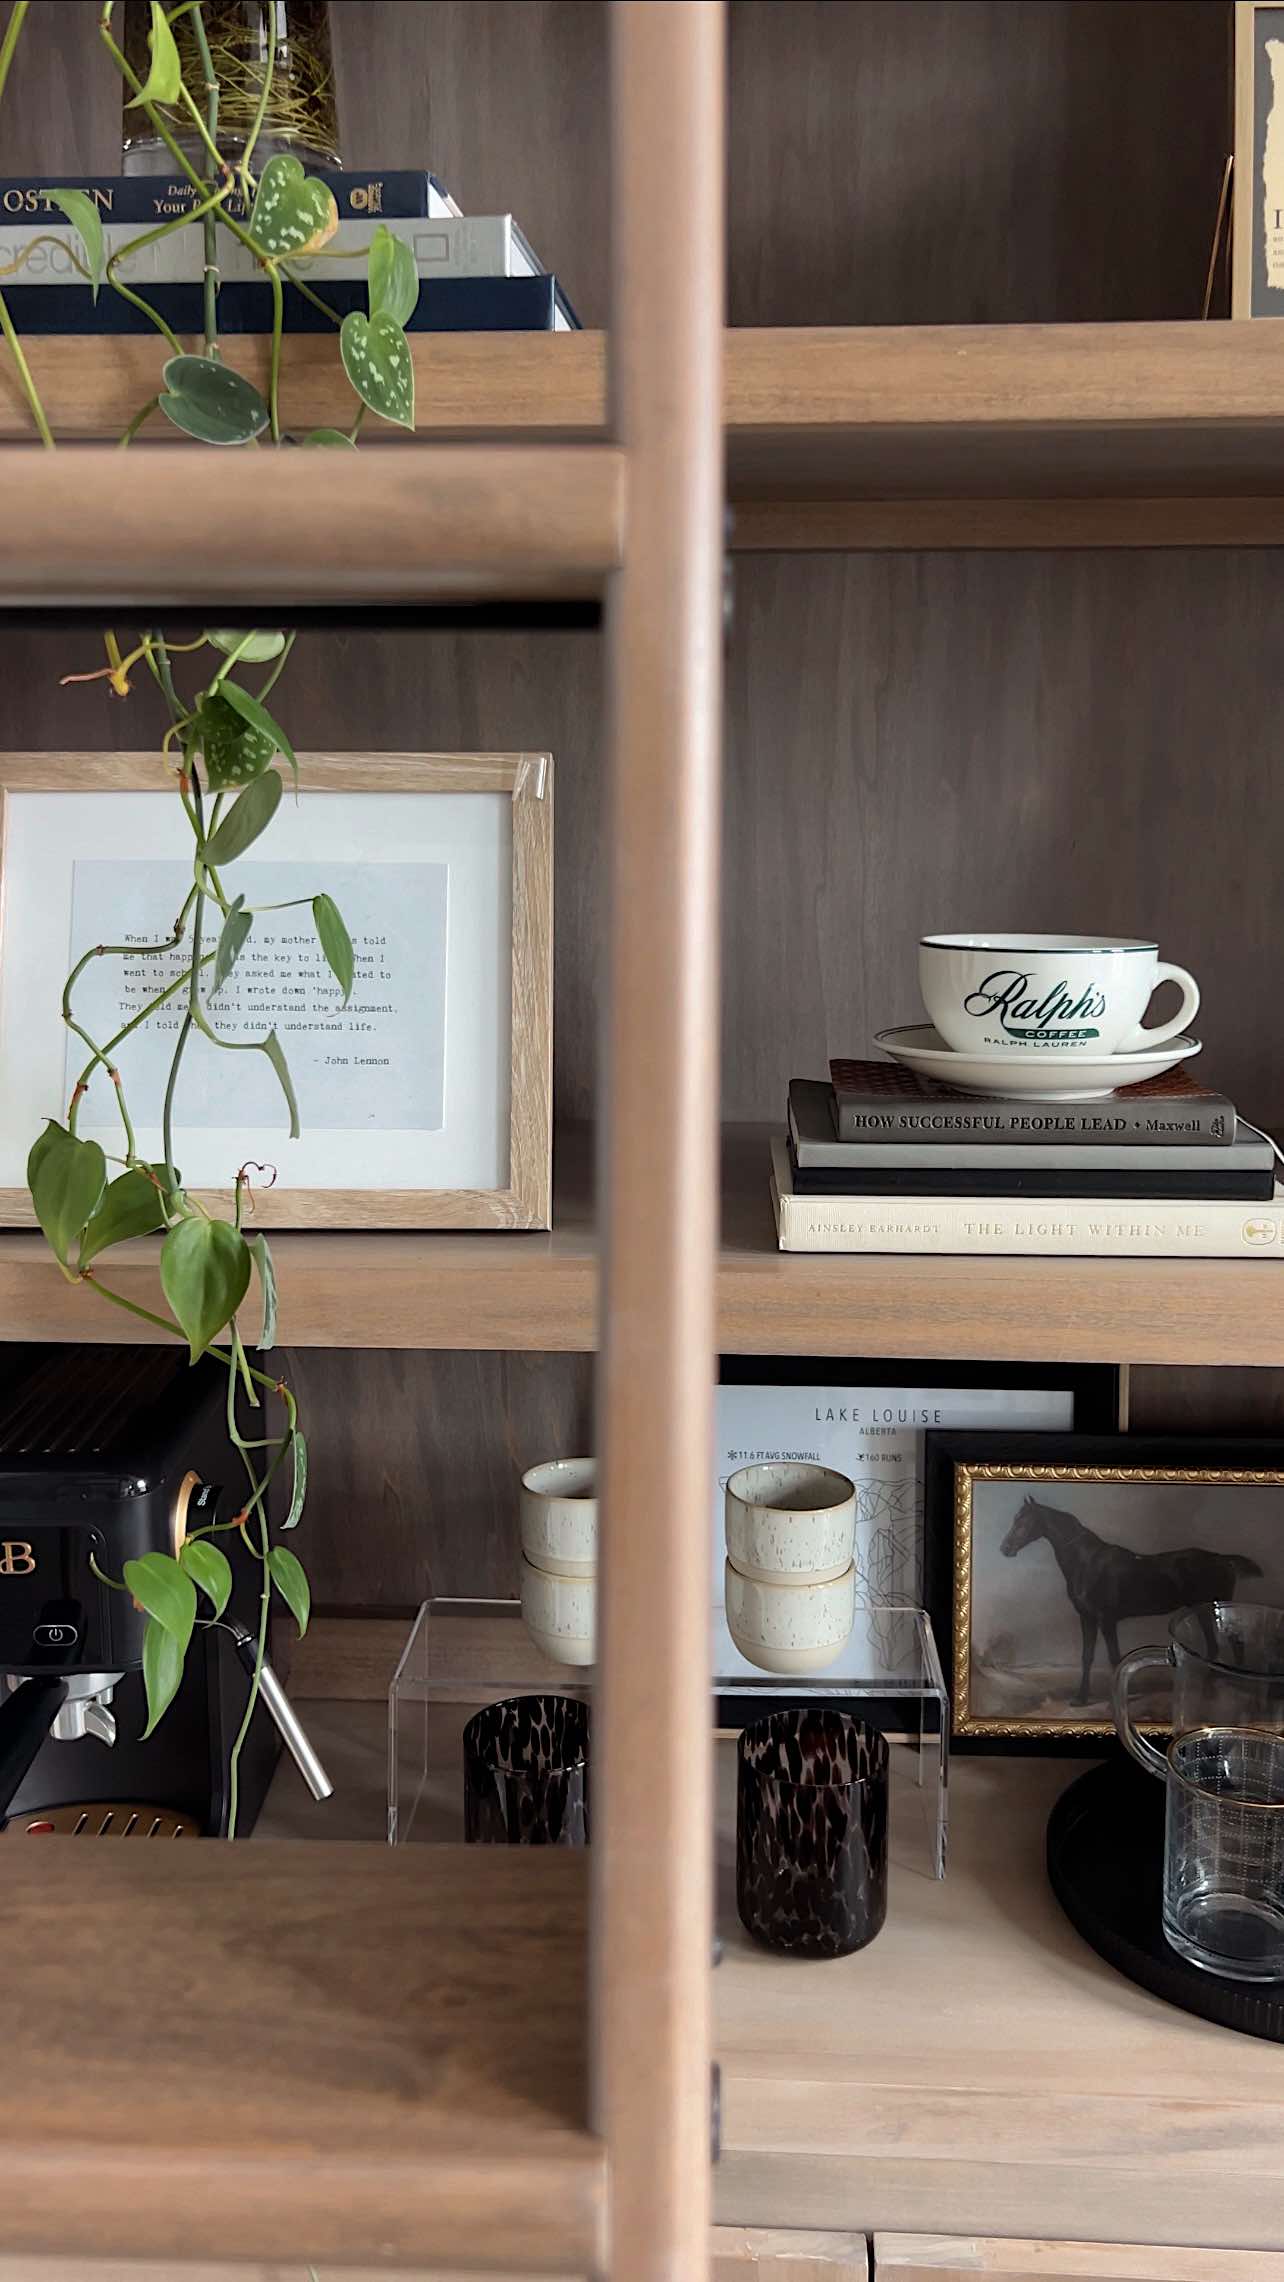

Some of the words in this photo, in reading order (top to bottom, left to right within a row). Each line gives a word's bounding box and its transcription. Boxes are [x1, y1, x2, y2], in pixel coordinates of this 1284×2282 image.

[167, 185, 197, 198] Daily
[3, 188, 114, 212] OSTN
[153, 199, 187, 214] Your
[124, 934, 149, 943] When
[263, 937, 276, 946] my
[281, 936, 318, 945] mother
[363, 936, 387, 945] told
[252, 952, 269, 961] the
[274, 953, 291, 964] key
[298, 953, 310, 962] to
[123, 969, 147, 977] went
[152, 969, 164, 977] to
[245, 969, 275, 978] asked
[298, 969, 321, 978] what
[380, 970, 392, 980] to
[125, 985, 136, 994] be
[142, 985, 167, 994] when
[247, 986, 276, 994] wrote
[281, 986, 306, 995] down
[964, 970, 1106, 1029] Ralph's
[119, 1002, 143, 1013] They
[206, 1002, 241, 1011] didn't
[247, 1002, 306, 1012] understand
[312, 1003, 329, 1012] the
[156, 1020, 180, 1029] told
[215, 1021, 239, 1032] they
[243, 1021, 279, 1030] didn't
[284, 1021, 343, 1031] understand
[349, 1021, 377, 1031] life.
[1024, 1030, 1088, 1039] COFFEE
[984, 1036, 1028, 1047] RALPH
[1033, 1040, 1088, 1049] LAUREN
[324, 1056, 349, 1065] John
[353, 1056, 391, 1066] Lennon
[854, 1114, 895, 1129] HOW
[899, 1115, 1005, 1130] SUCCESSFUL
[1009, 1116, 1076, 1130] PEOPLE
[1081, 1117, 1127, 1131] LEAD
[1145, 1119, 1201, 1132] Maxwell
[808, 1223, 864, 1233] AINSLEY
[869, 1223, 939, 1234] EARHARDT
[963, 1222, 1004, 1236] THE
[1014, 1223, 1078, 1236] LIGHT
[1088, 1223, 1168, 1237] WITHIN
[1176, 1225, 1209, 1238] ME
[815, 1407, 860, 1421] LAKE
[872, 1408, 942, 1423] LOUISE
[859, 1426, 897, 1436] ALBERTA
[781, 1451, 821, 1461] SNOWFALL
